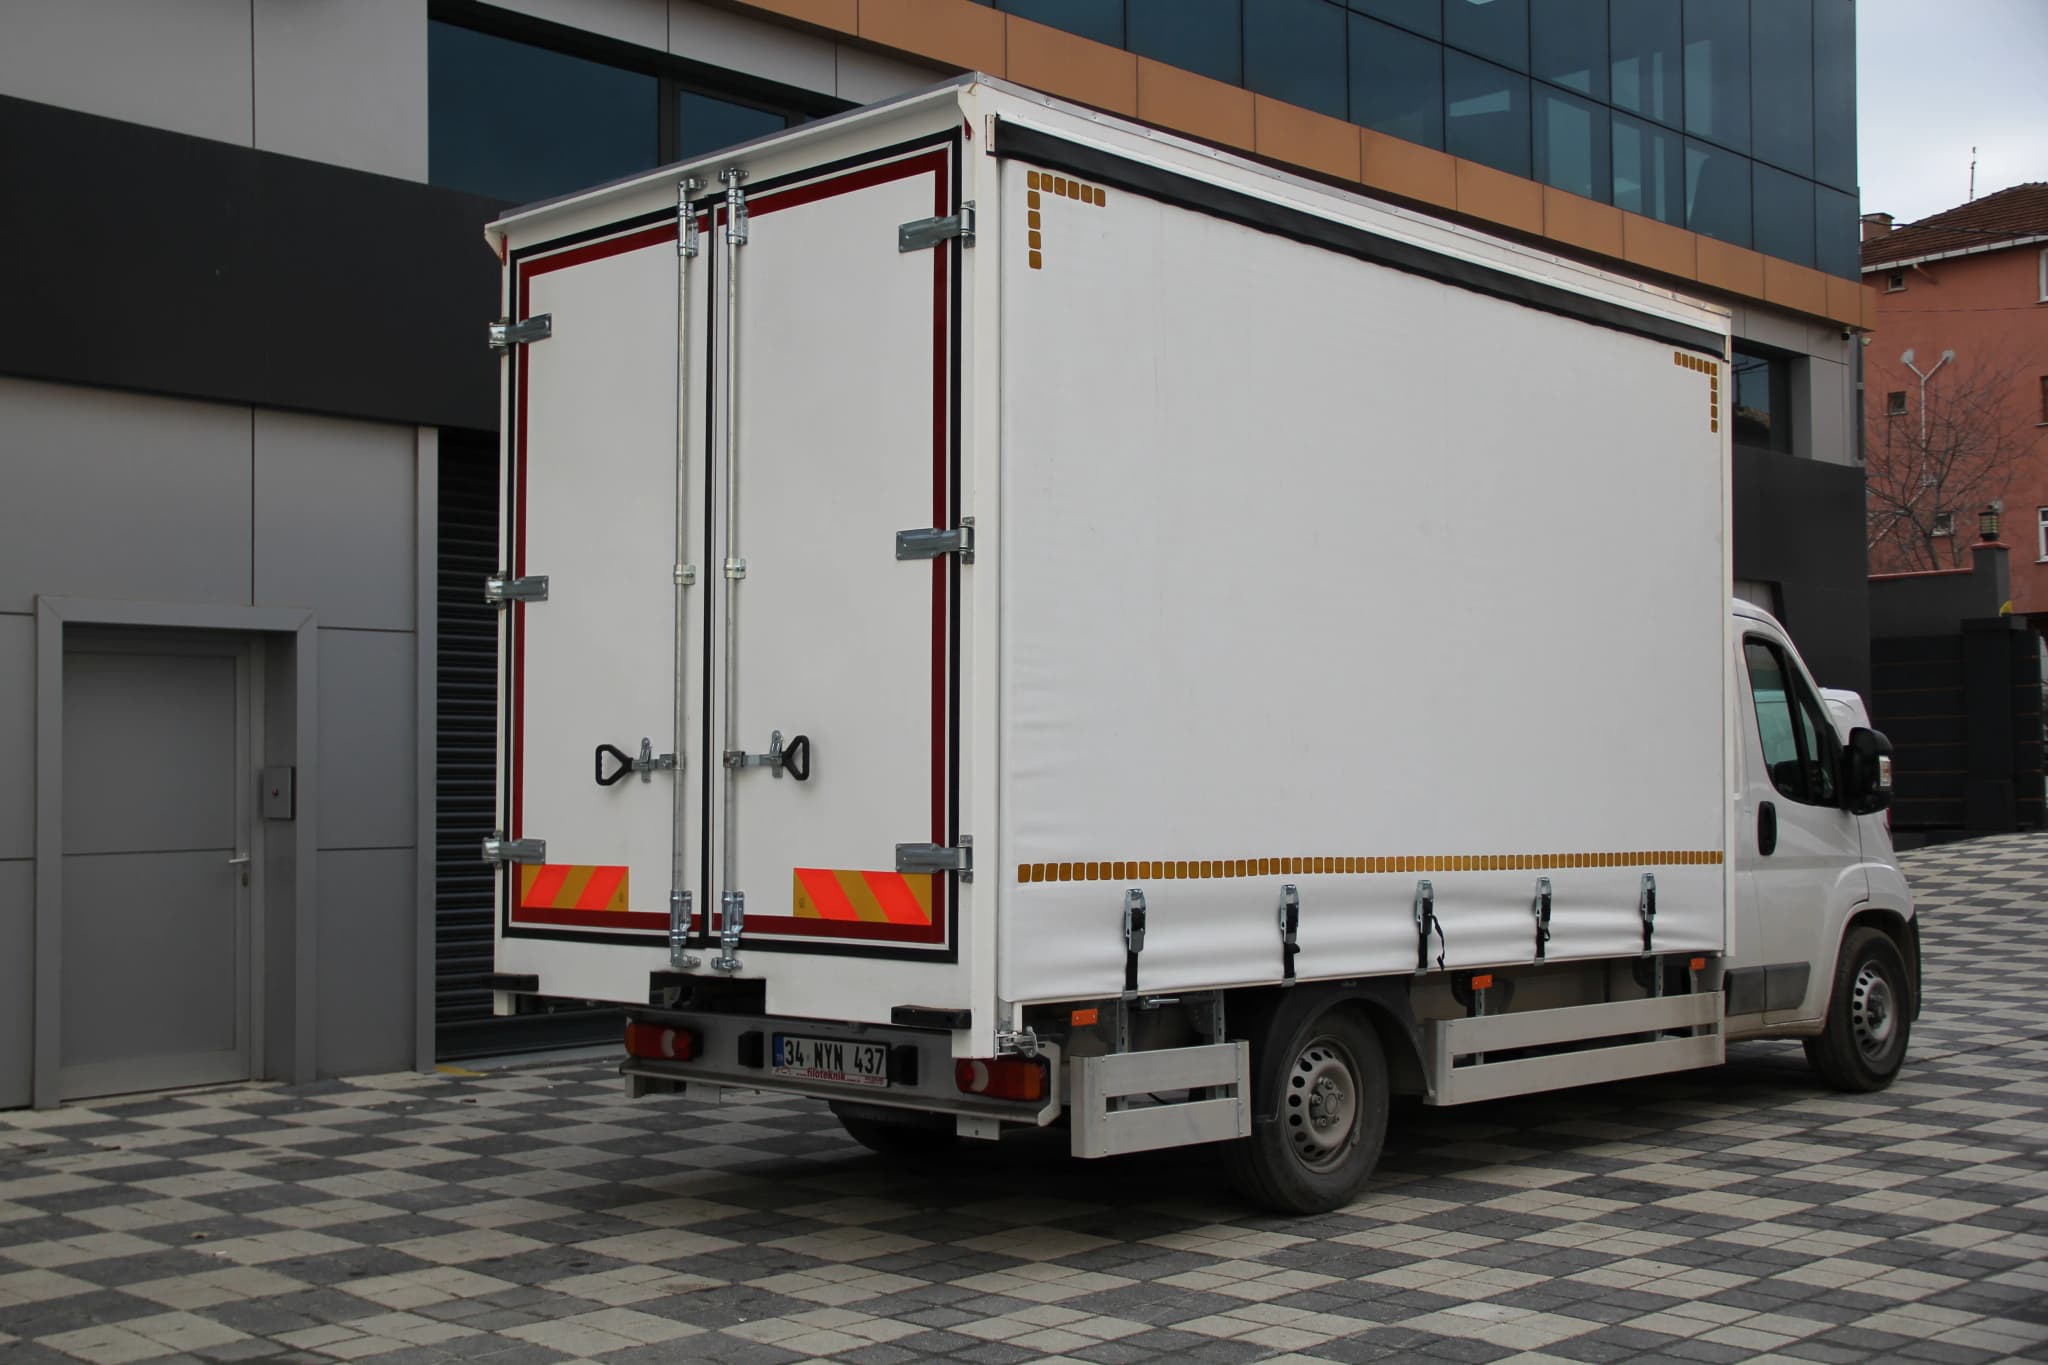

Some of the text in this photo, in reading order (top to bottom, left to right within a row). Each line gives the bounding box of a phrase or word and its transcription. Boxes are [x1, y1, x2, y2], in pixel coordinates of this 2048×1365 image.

[785, 1040, 884, 1075] 34 NYN 437
